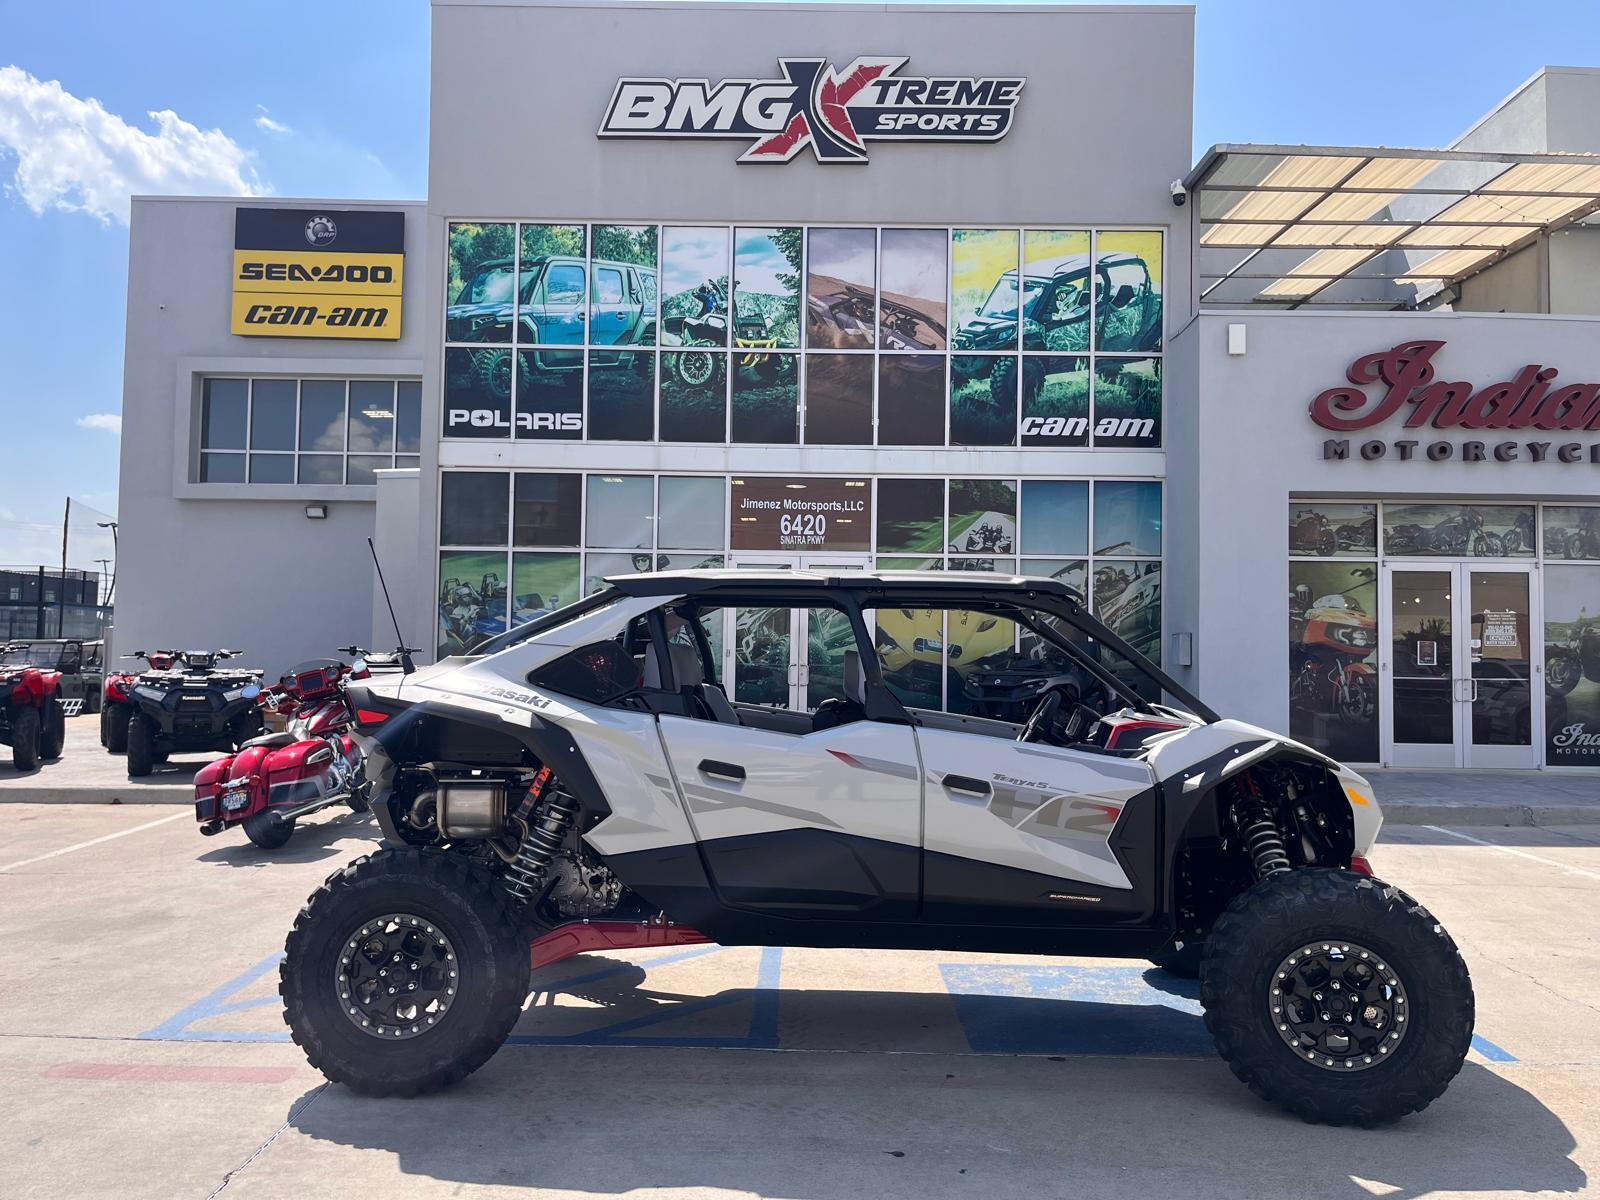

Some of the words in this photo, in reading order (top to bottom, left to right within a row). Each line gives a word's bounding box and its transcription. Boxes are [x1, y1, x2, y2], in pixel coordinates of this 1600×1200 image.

[606, 84, 799, 131] BMG
[875, 113, 1002, 131] SPORTS
[244, 304, 389, 328] can-am
[449, 409, 583, 430] POLARIS
[1021, 416, 1155, 437] canam
[740, 498, 781, 510] Jimenez
[783, 499, 865, 512] Motorsports,LLC
[780, 514, 826, 535] 6420
[780, 535, 807, 545] SINATRA
[807, 535, 826, 545] PKWY
